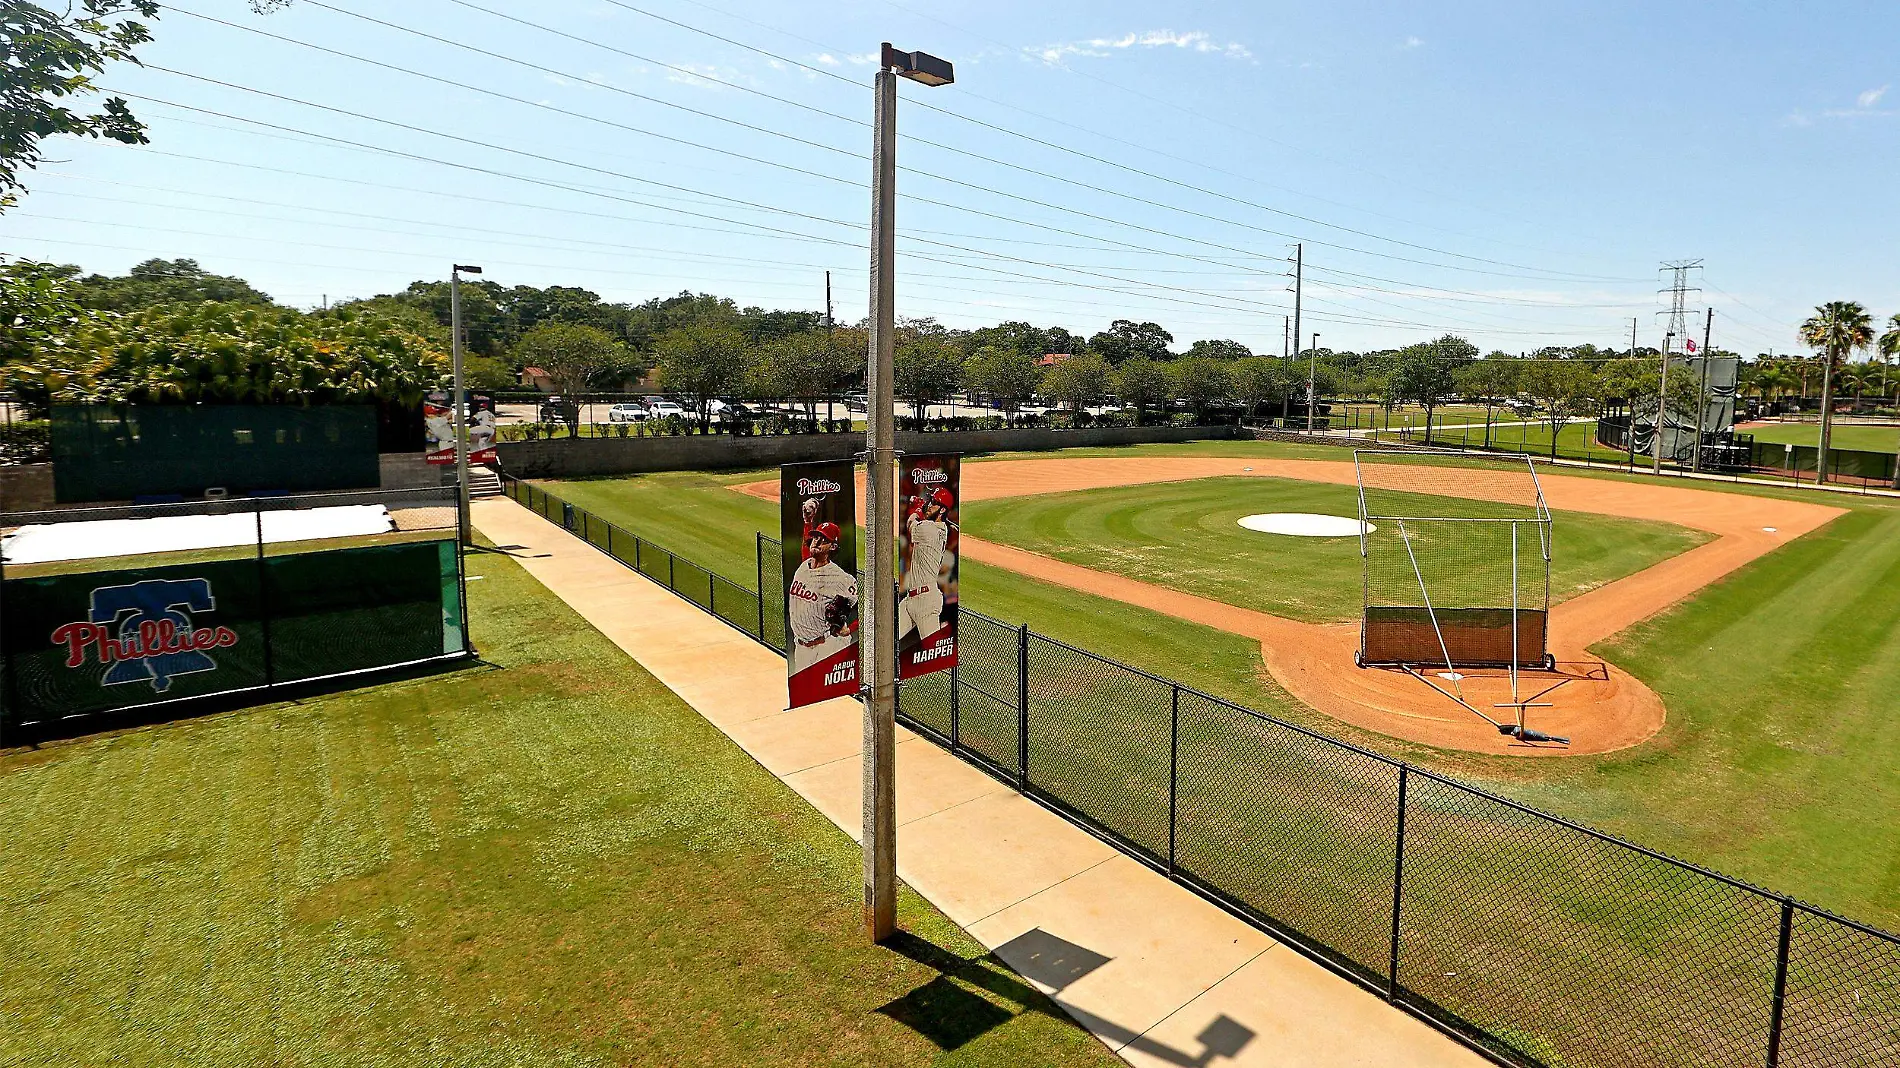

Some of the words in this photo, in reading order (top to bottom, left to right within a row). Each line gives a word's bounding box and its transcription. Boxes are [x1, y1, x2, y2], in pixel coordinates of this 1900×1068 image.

[911, 467, 948, 484] Phillies
[796, 477, 841, 495] Phillies
[51, 618, 238, 668] Phillies
[912, 644, 954, 665] HARPER
[832, 660, 856, 672] AARON
[824, 668, 855, 687] NOLA
